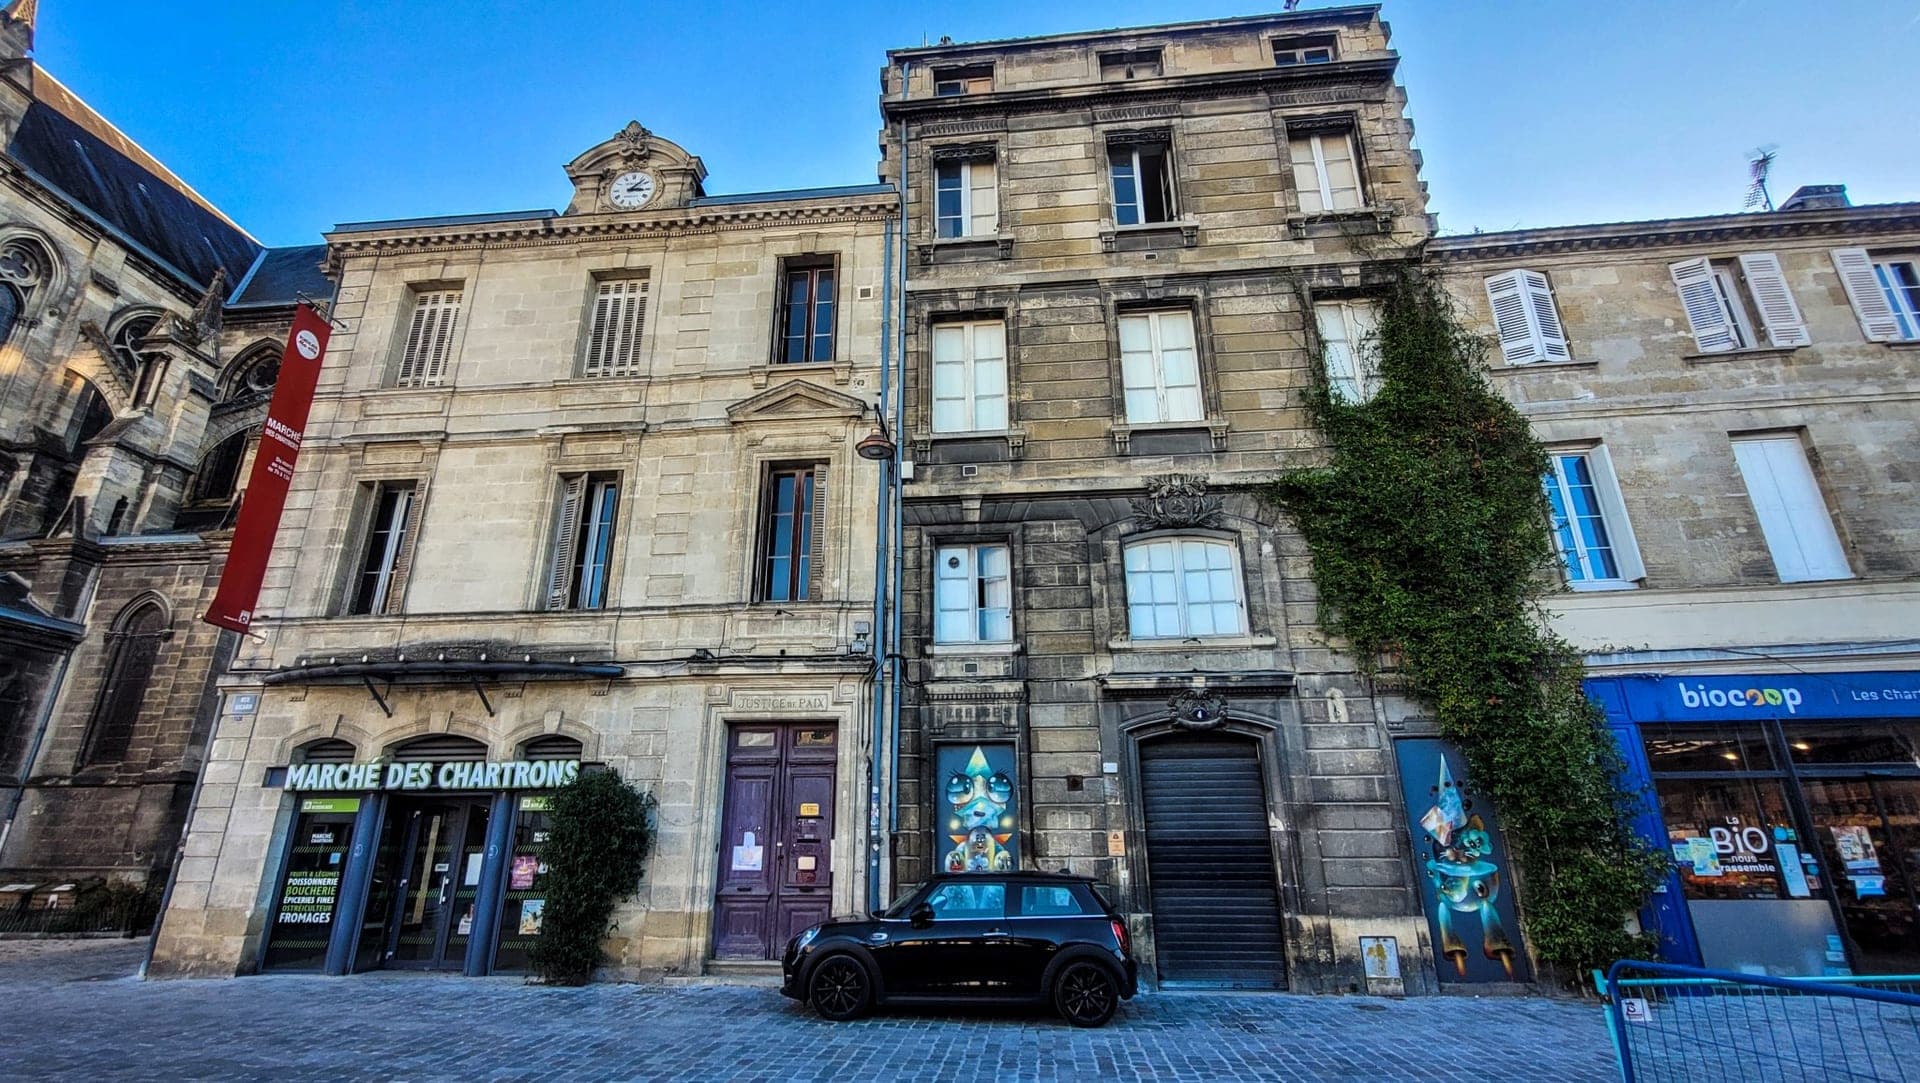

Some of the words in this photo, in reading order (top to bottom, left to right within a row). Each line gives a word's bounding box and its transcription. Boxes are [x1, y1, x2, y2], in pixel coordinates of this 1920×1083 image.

[267, 417, 302, 443] MARCHÉ
[1679, 682, 1802, 714] biocoop
[1851, 690, 1880, 701] Les
[1883, 688, 1920, 700] Char
[738, 698, 786, 709] JUSTICE
[799, 698, 825, 709] PAIX
[284, 756, 384, 791] MARCHÉ
[385, 762, 434, 790] DES
[438, 760, 580, 789] CHARTRONS
[1725, 815, 1740, 825] La
[1731, 855, 1758, 863] nous
[1720, 863, 1776, 872] rassemble
[287, 878, 339, 886] POISSONNERIE
[286, 886, 337, 896] BOUCHERIE
[316, 896, 335, 904] FINES
[279, 912, 332, 924] FROMAGES
